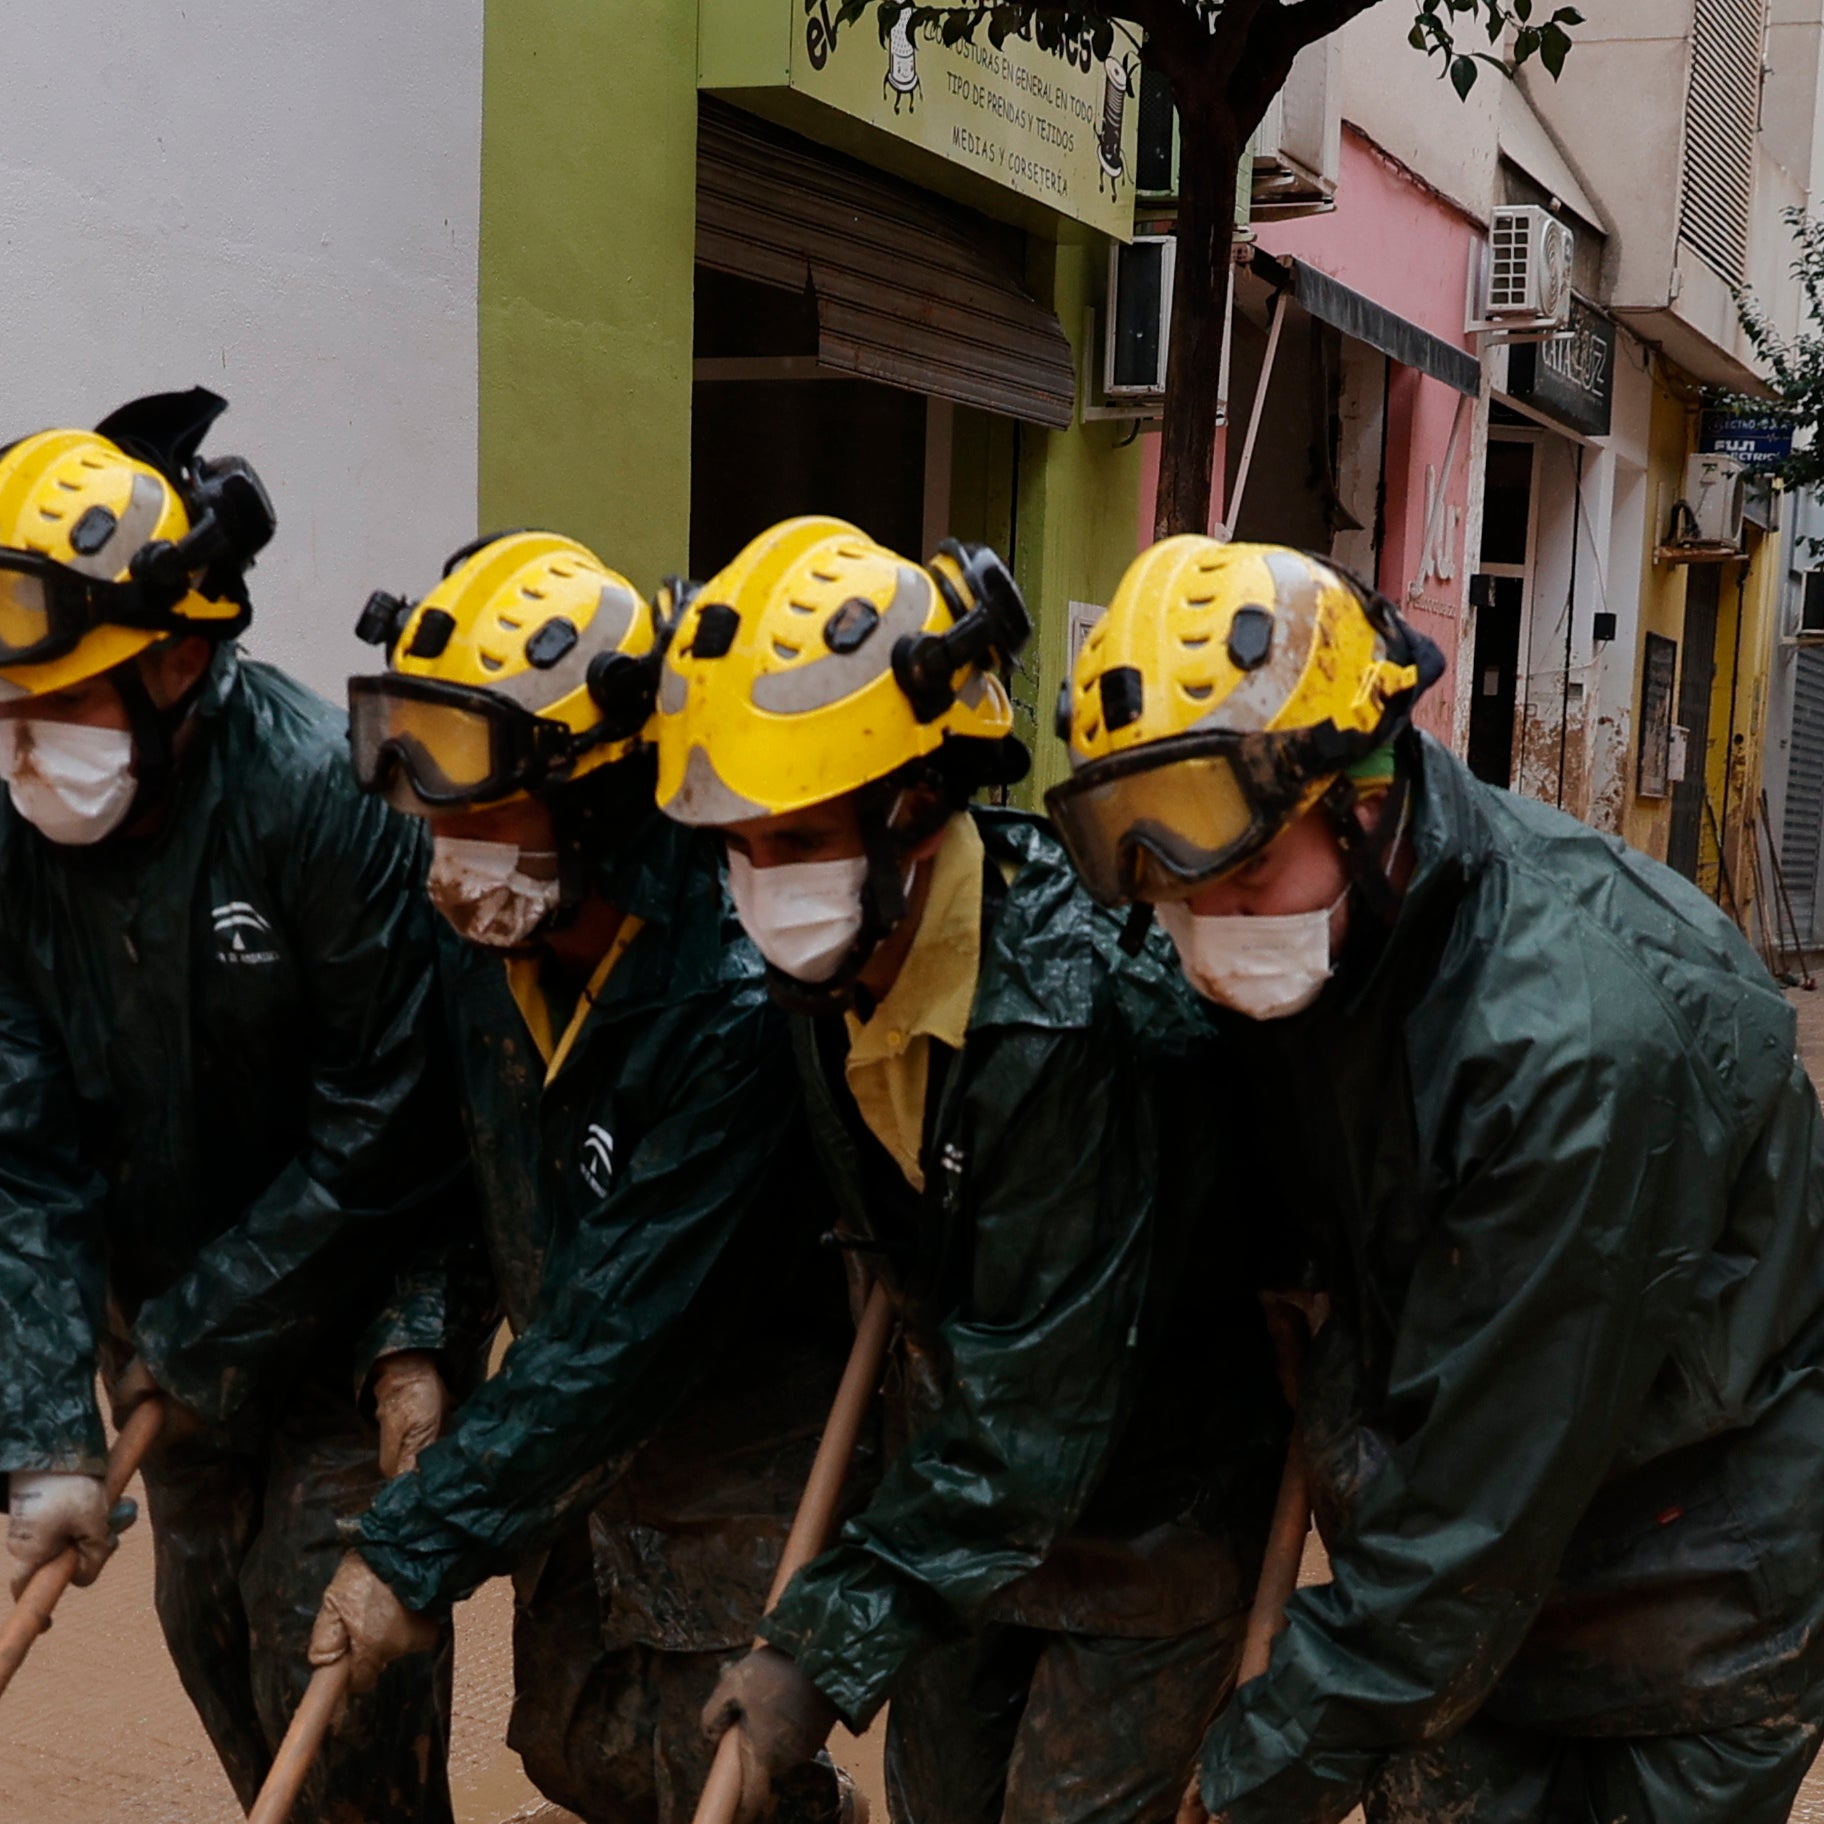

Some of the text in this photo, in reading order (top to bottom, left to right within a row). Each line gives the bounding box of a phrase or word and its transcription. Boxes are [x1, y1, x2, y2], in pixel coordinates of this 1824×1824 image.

[923, 20, 1000, 75] COOSTURAS
[1002, 58, 1014, 83] EN
[1015, 66, 1053, 105] GENERAL
[1055, 88, 1068, 111] EN
[1070, 95, 1093, 125] TODO
[946, 71, 1075, 152] TIPO DE PRENDAS Y TEJIDOS
[952, 125, 1068, 196] MEDIAS Y CORSETERÍA
[1714, 440, 1756, 451] FUJI
